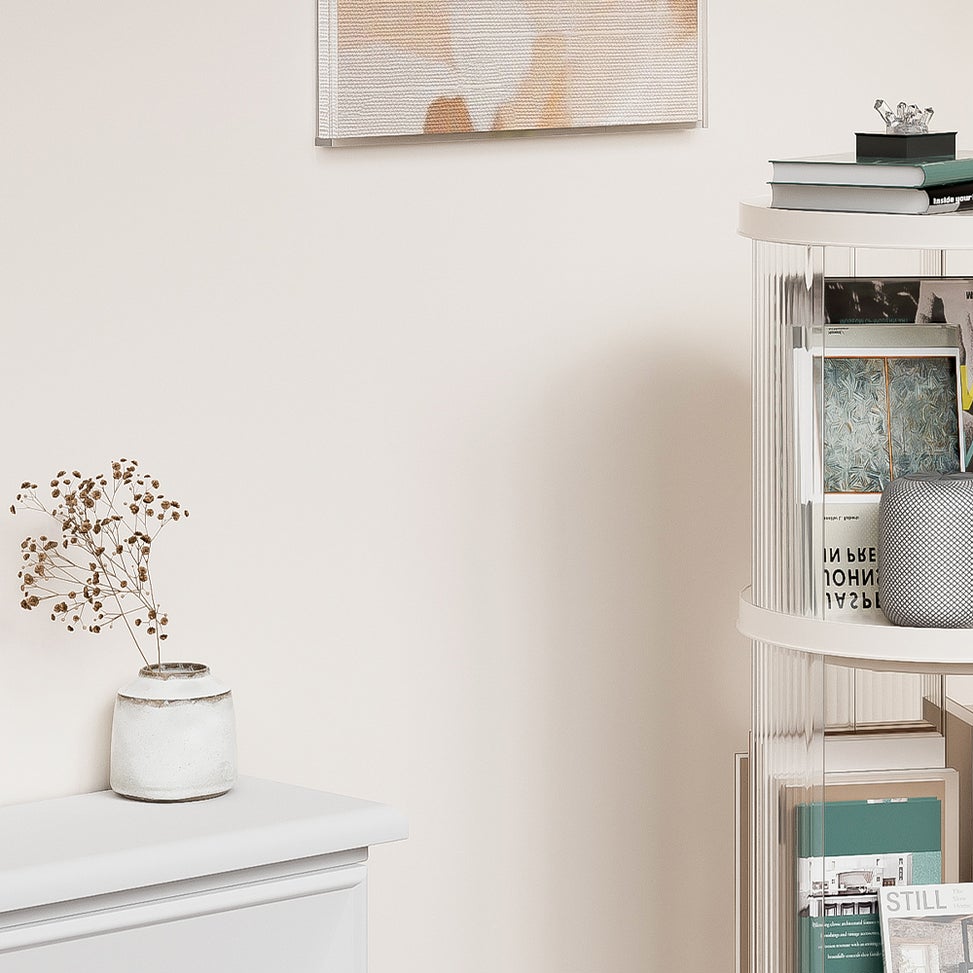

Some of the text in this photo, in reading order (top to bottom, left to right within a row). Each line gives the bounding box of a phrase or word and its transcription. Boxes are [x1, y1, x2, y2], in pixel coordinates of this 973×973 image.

[933, 196, 954, 205] Inside
[955, 194, 973, 204] your
[886, 889, 947, 911] STILL
